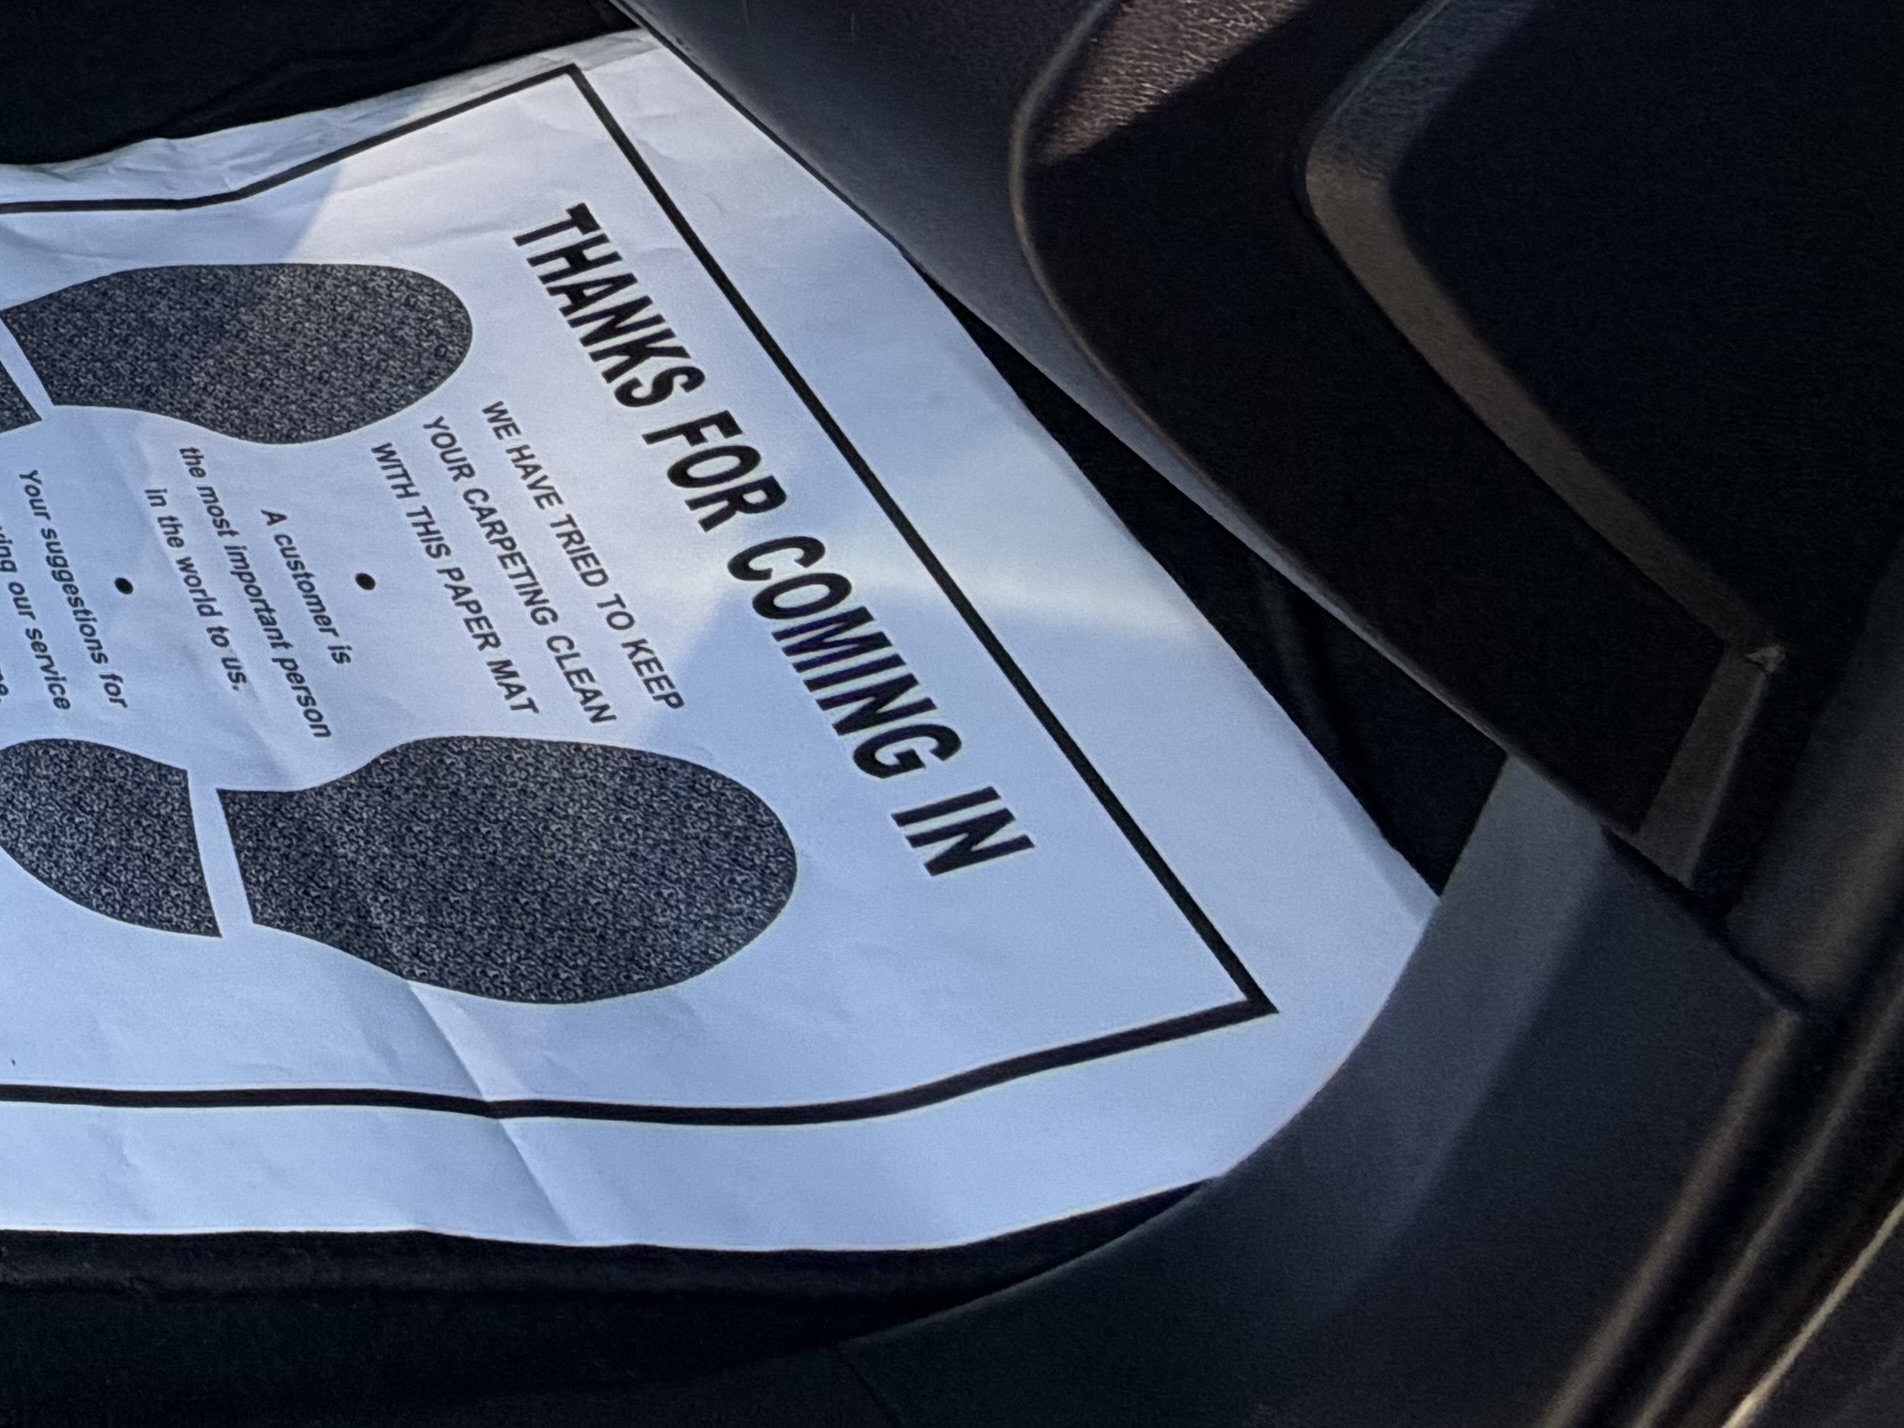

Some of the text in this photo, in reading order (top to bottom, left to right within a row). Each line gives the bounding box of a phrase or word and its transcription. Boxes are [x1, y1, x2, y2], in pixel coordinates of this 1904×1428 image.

[8, 581, 37, 621] our
[24, 626, 72, 711] service
[19, 469, 128, 710] Your suggestions for
[144, 487, 248, 692] in the world to us.
[179, 446, 332, 739] the most important person
[260, 509, 352, 665] A customer is
[371, 442, 539, 714] WITH THIS PAPER MAT
[423, 416, 617, 724] YOUR CARPETING CLEAN
[482, 400, 685, 710] WE HAVE TRIED TO KEEP
[512, 201, 1037, 878] THANKS FOR COMING IN
